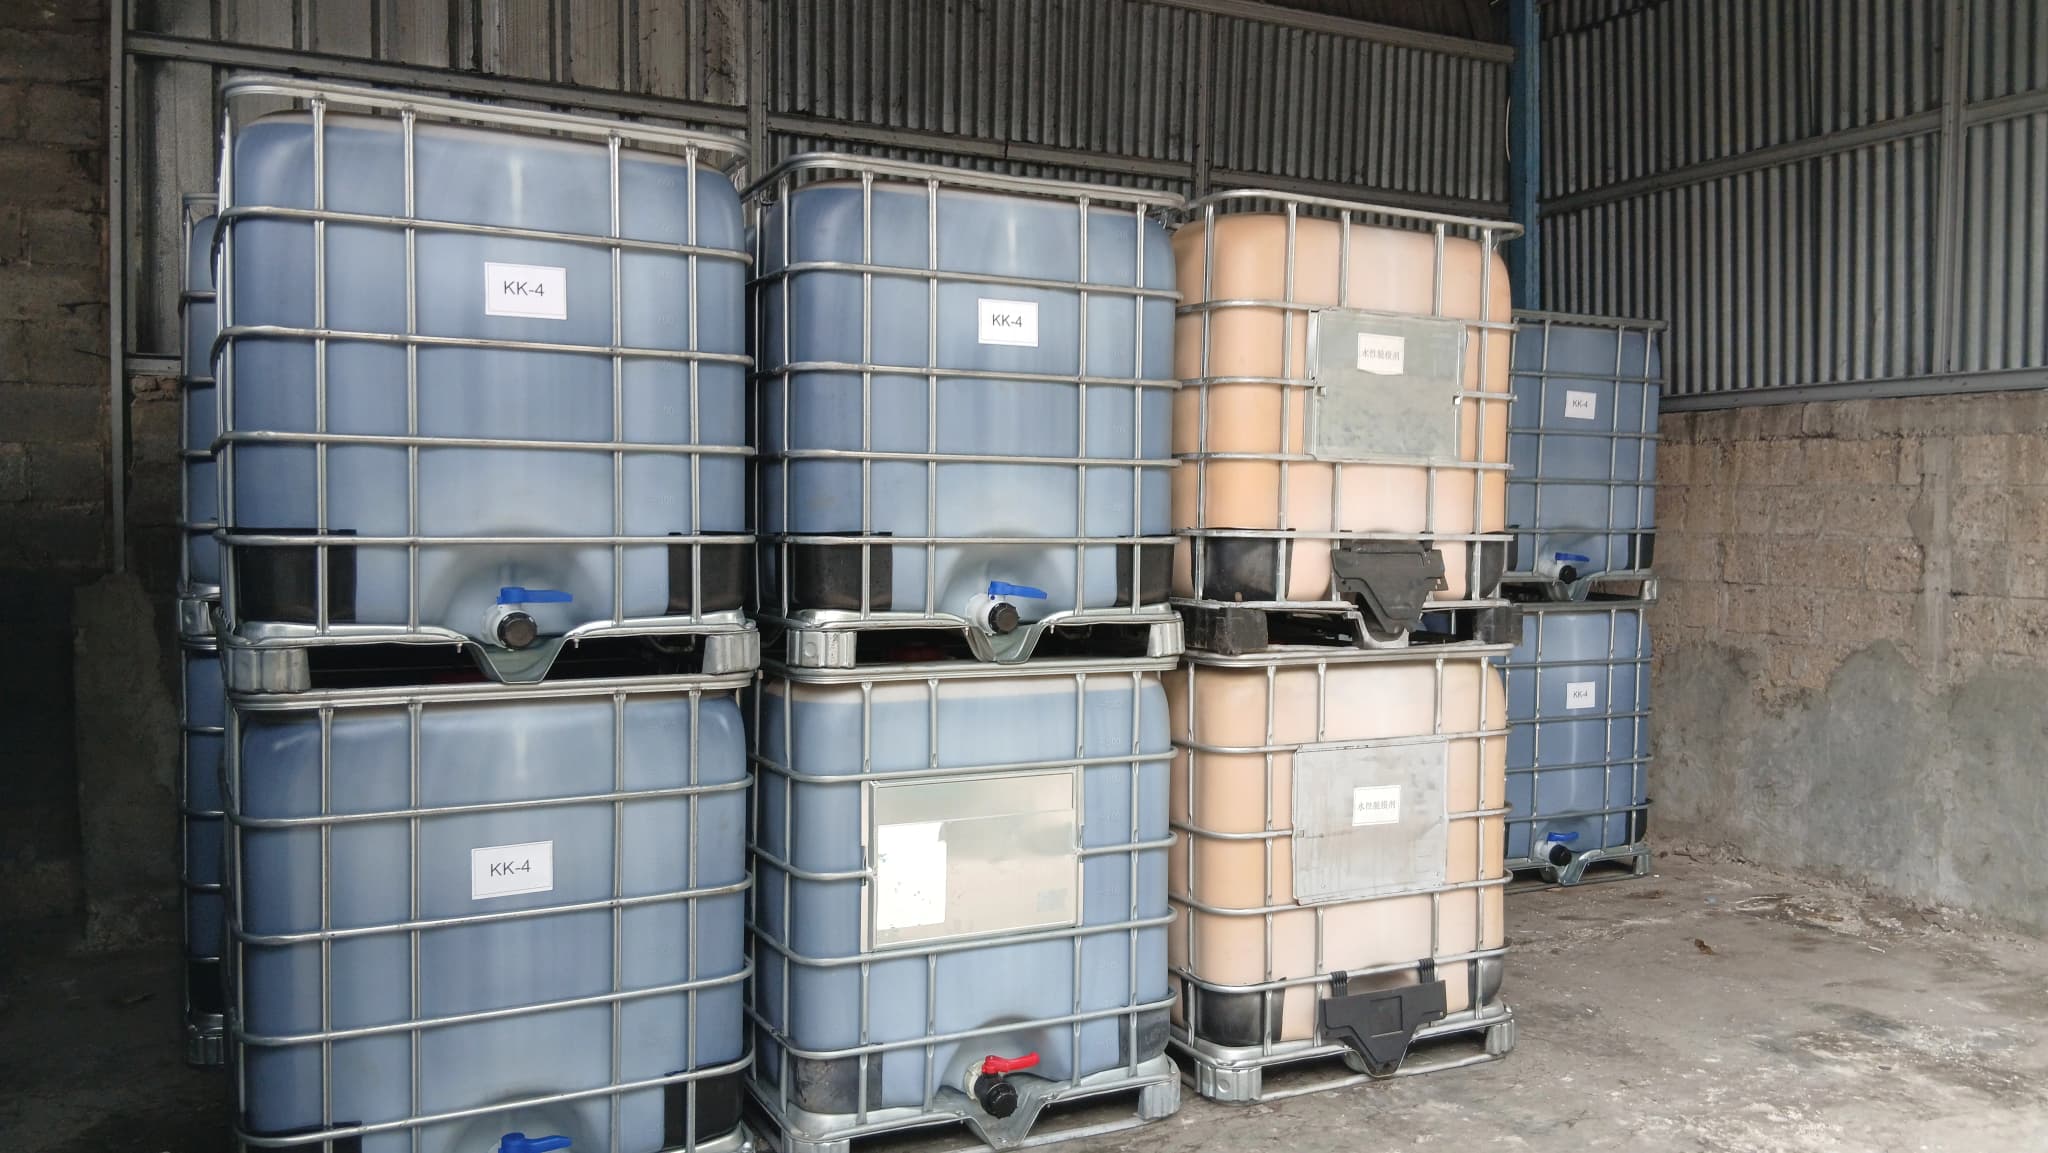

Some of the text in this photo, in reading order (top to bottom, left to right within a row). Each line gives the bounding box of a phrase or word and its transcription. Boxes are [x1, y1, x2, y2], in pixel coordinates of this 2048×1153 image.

[503, 280, 545, 297] KK-4
[992, 313, 1023, 328] KK-4
[1572, 399, 1588, 408] KK-4
[1573, 690, 1588, 698] KK-4
[490, 859, 532, 877] KK-4
